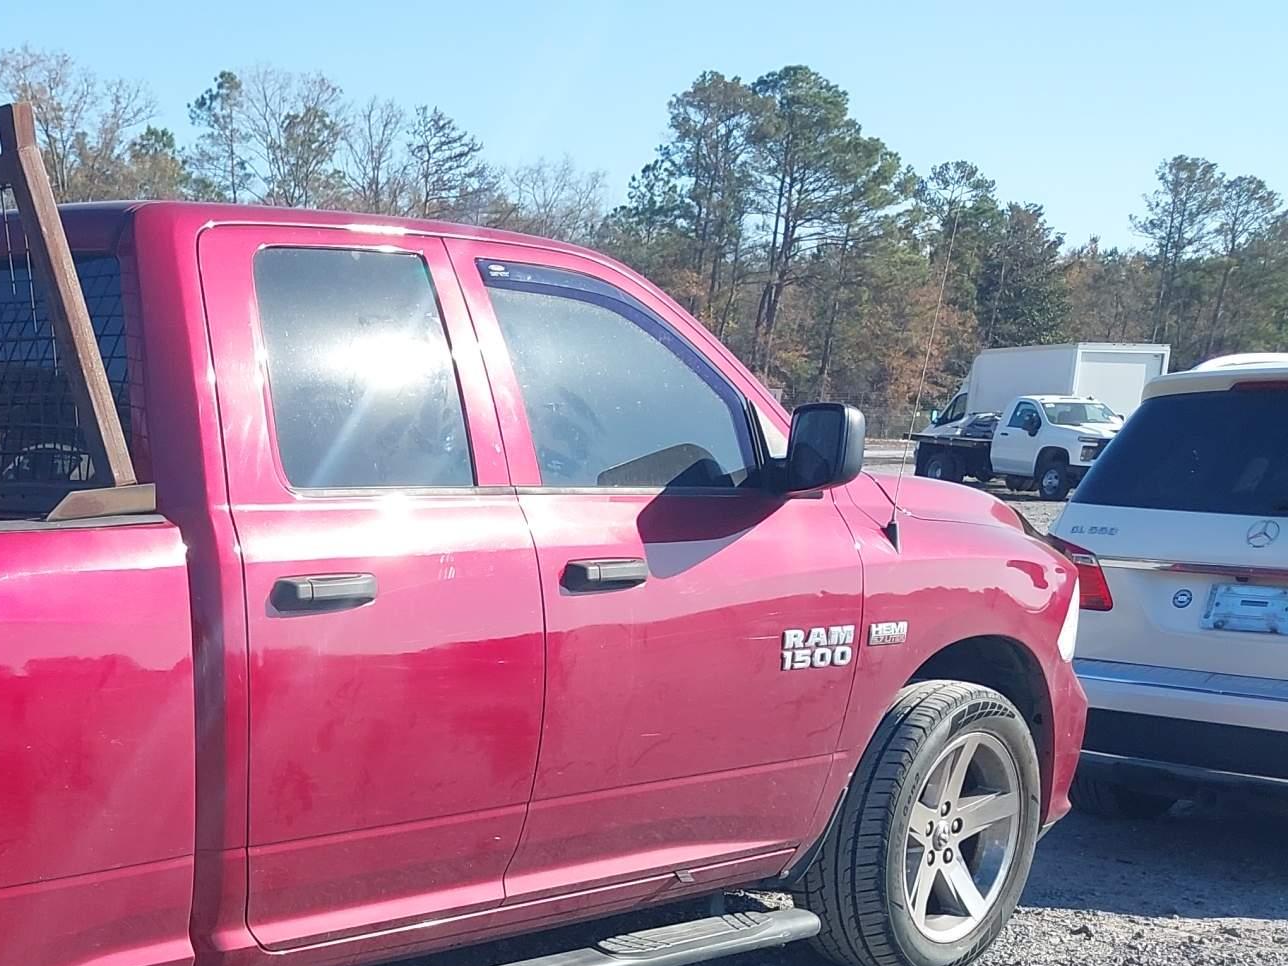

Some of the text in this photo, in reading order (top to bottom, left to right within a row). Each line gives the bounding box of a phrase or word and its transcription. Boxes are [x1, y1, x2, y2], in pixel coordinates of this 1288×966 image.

[783, 625, 855, 649] RAM
[870, 621, 908, 636] HEMI
[782, 646, 852, 671] 1500
